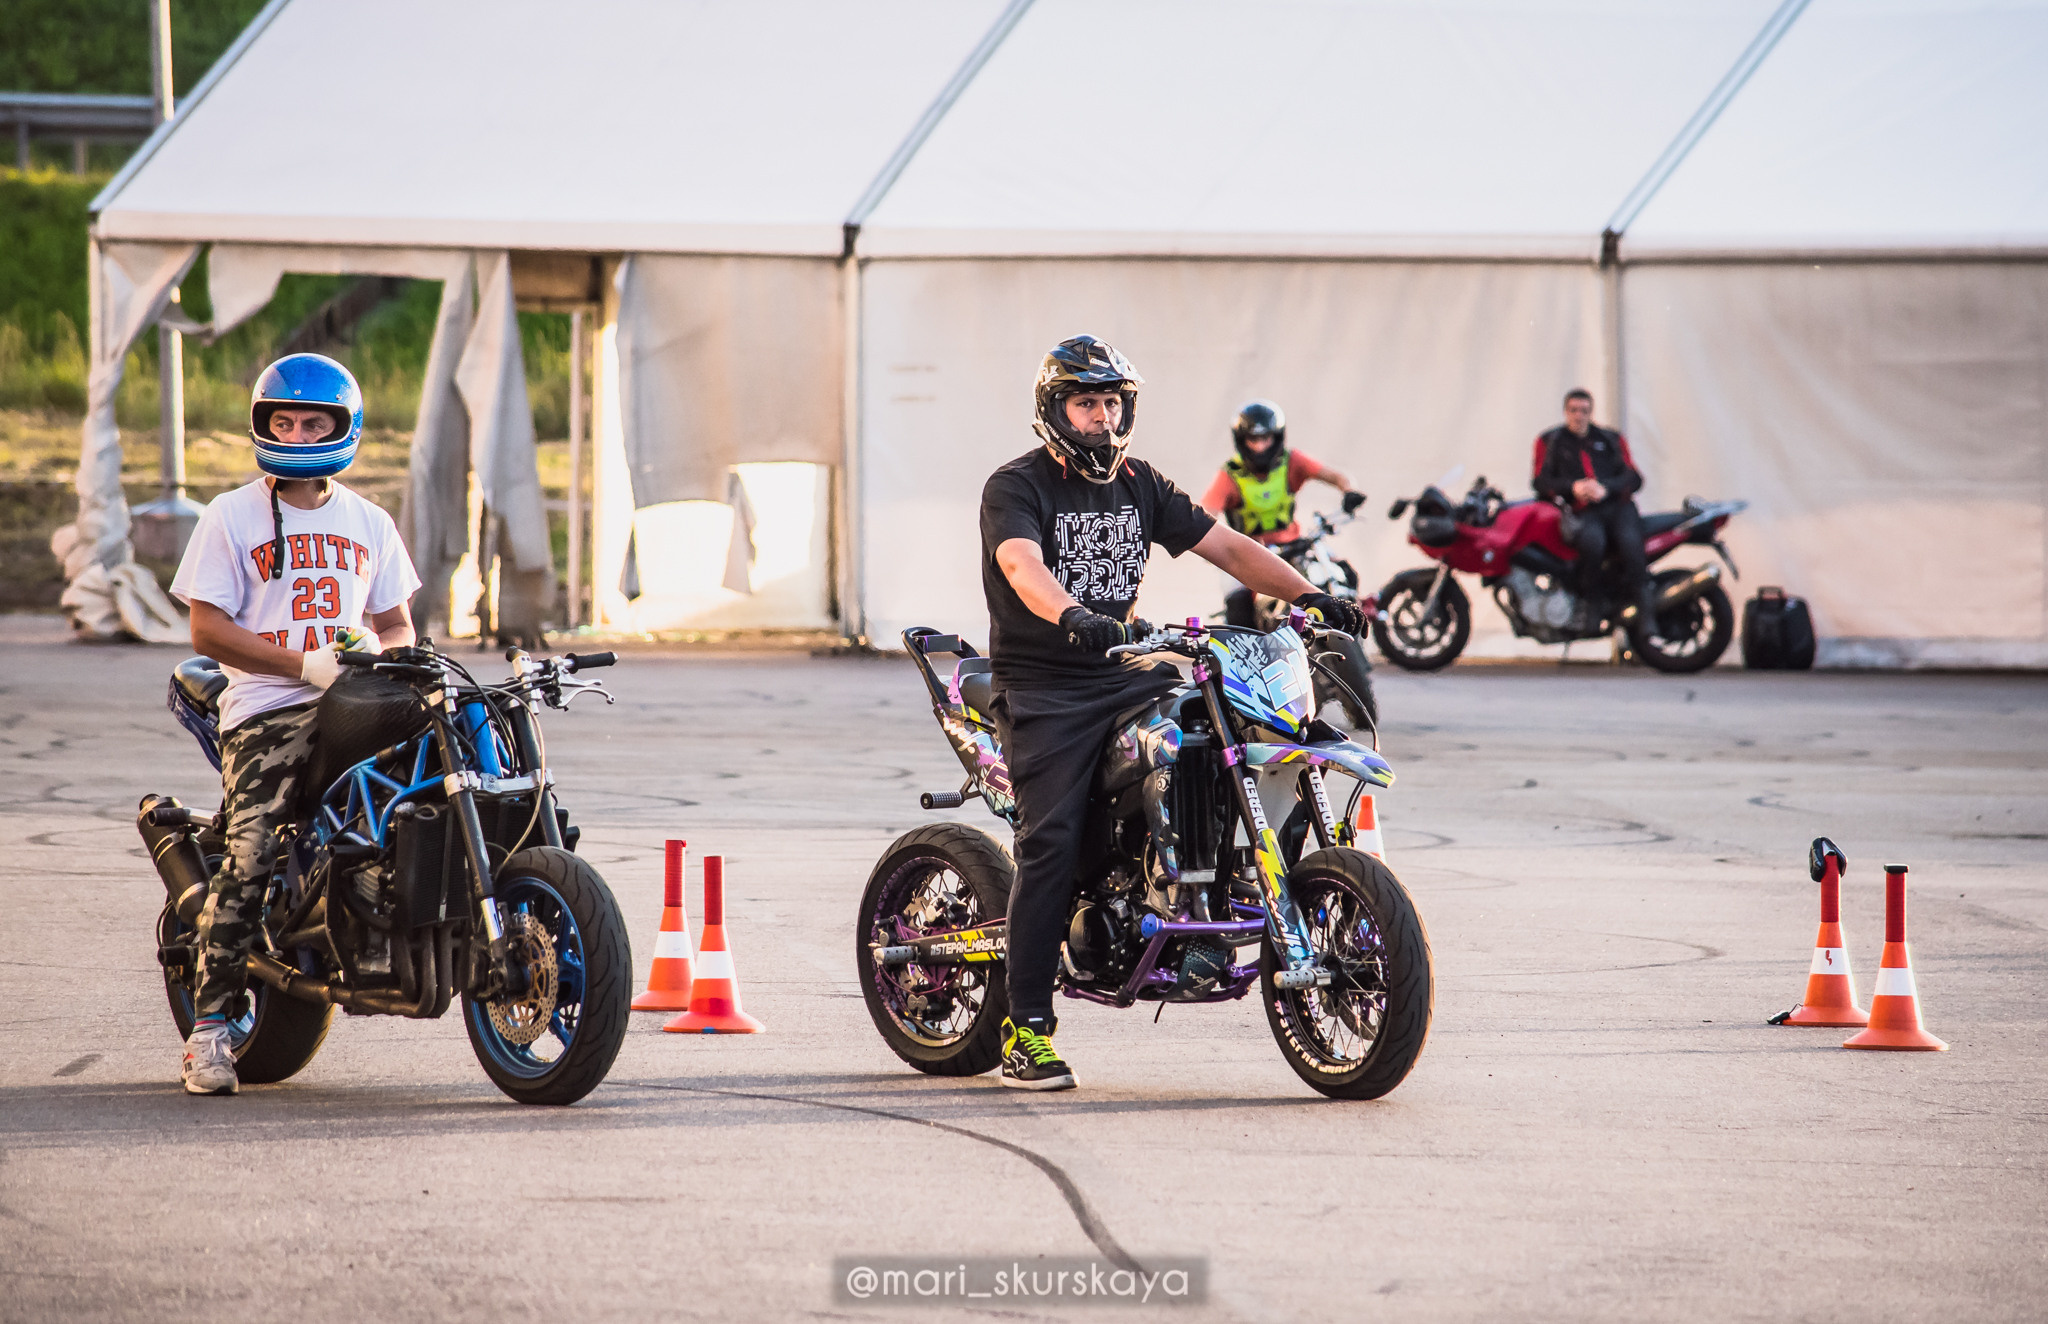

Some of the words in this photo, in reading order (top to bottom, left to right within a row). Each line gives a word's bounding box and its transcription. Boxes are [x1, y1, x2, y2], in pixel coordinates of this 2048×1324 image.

[250, 533, 370, 584] WHITE
[292, 576, 341, 621] 23
[1243, 777, 1269, 834] DERED
